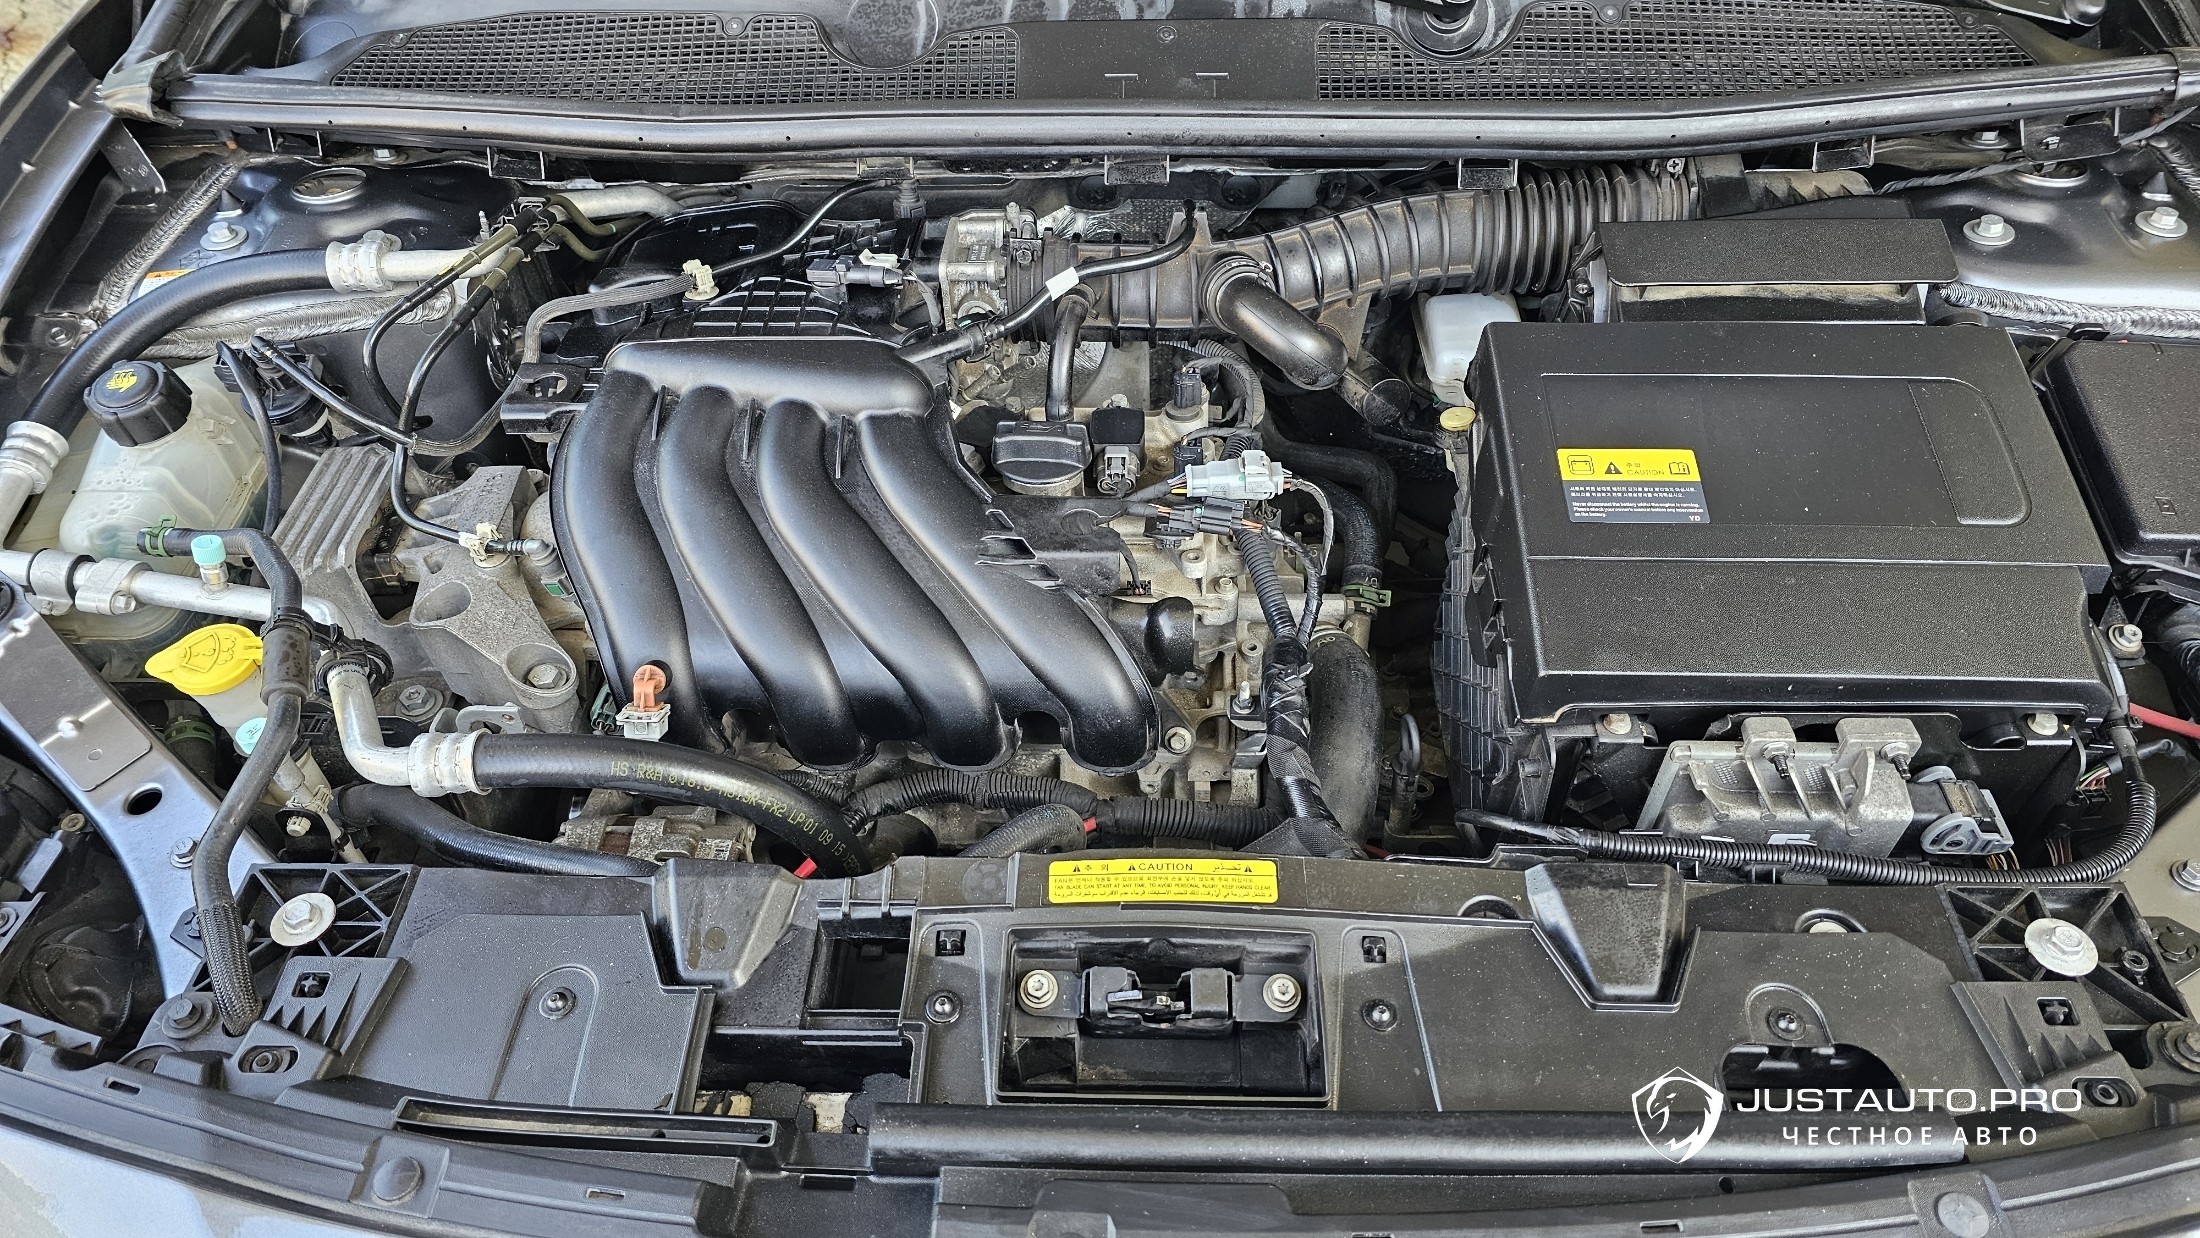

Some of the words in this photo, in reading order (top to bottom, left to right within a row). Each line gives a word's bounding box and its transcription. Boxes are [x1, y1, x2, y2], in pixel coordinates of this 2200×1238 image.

[610, 760, 629, 777] HS
[818, 829, 834, 845] 09
[831, 841, 847, 856] 15
[1138, 862, 1193, 871] CAUTION
